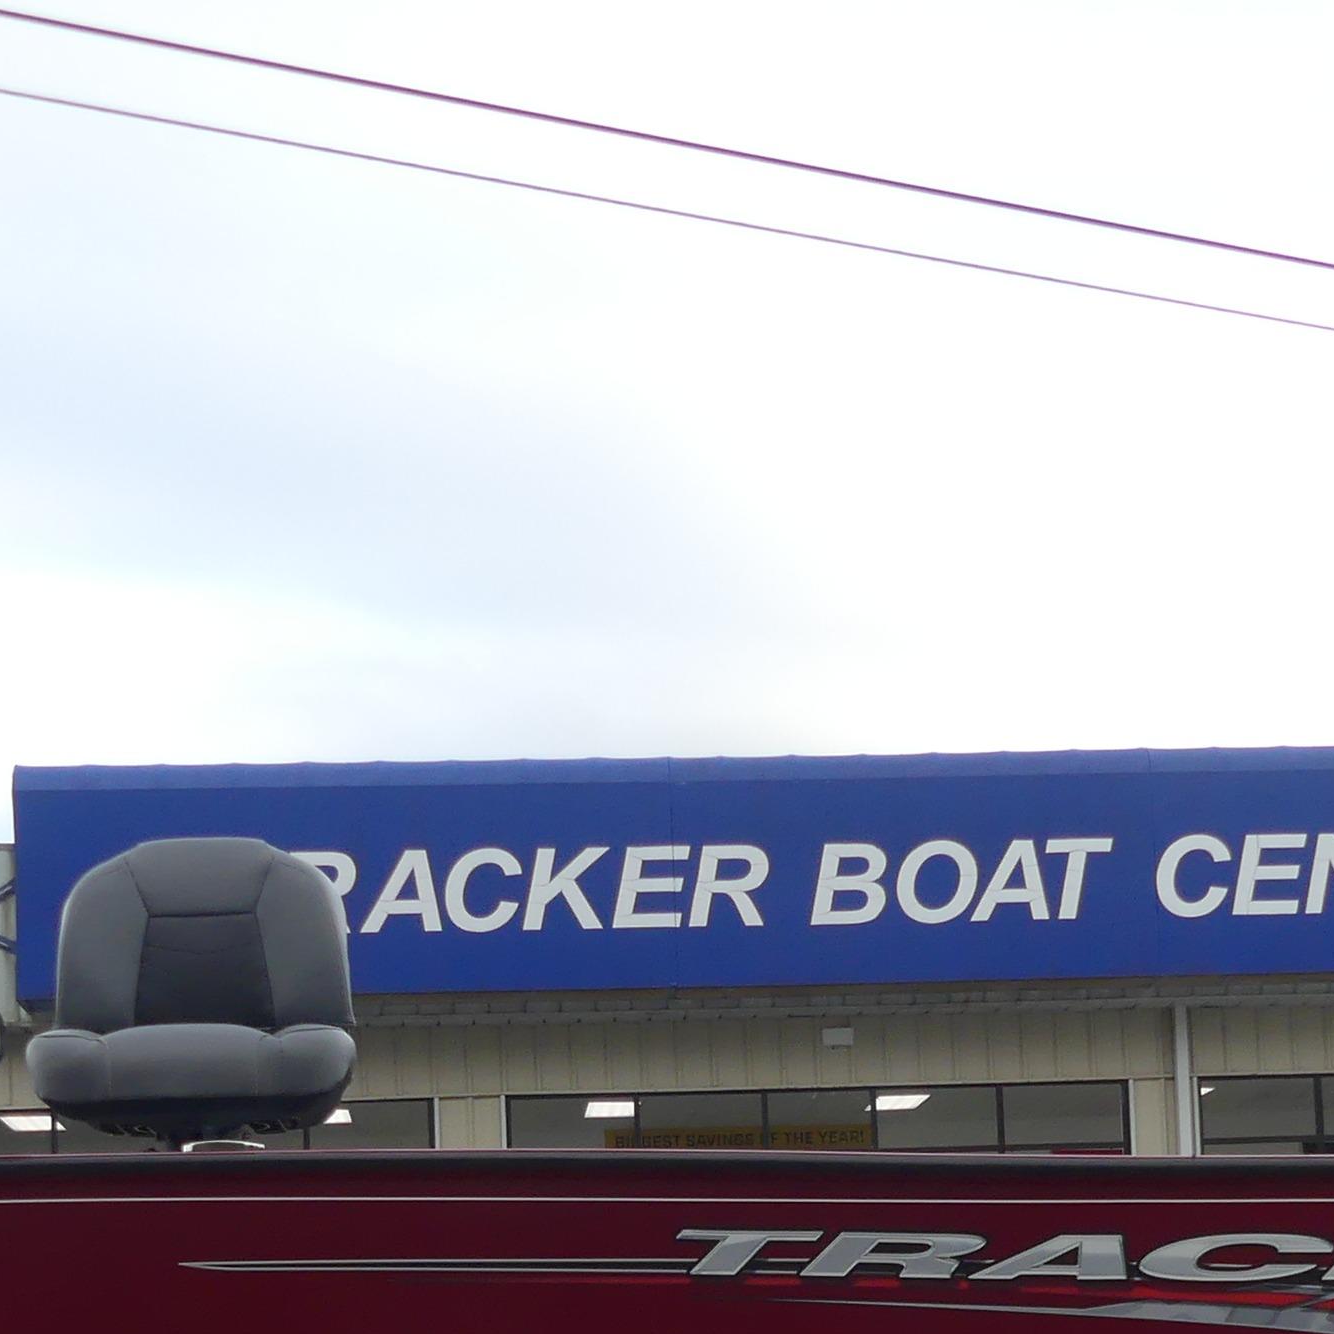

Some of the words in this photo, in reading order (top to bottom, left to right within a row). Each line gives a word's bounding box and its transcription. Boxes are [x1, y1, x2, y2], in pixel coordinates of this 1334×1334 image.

[289, 847, 770, 934] RACKER
[809, 836, 1114, 926] BOAT
[685, 1133, 755, 1147] SAVINGS
[783, 1131, 813, 1145] THE
[818, 1129, 865, 1144] YEAR!
